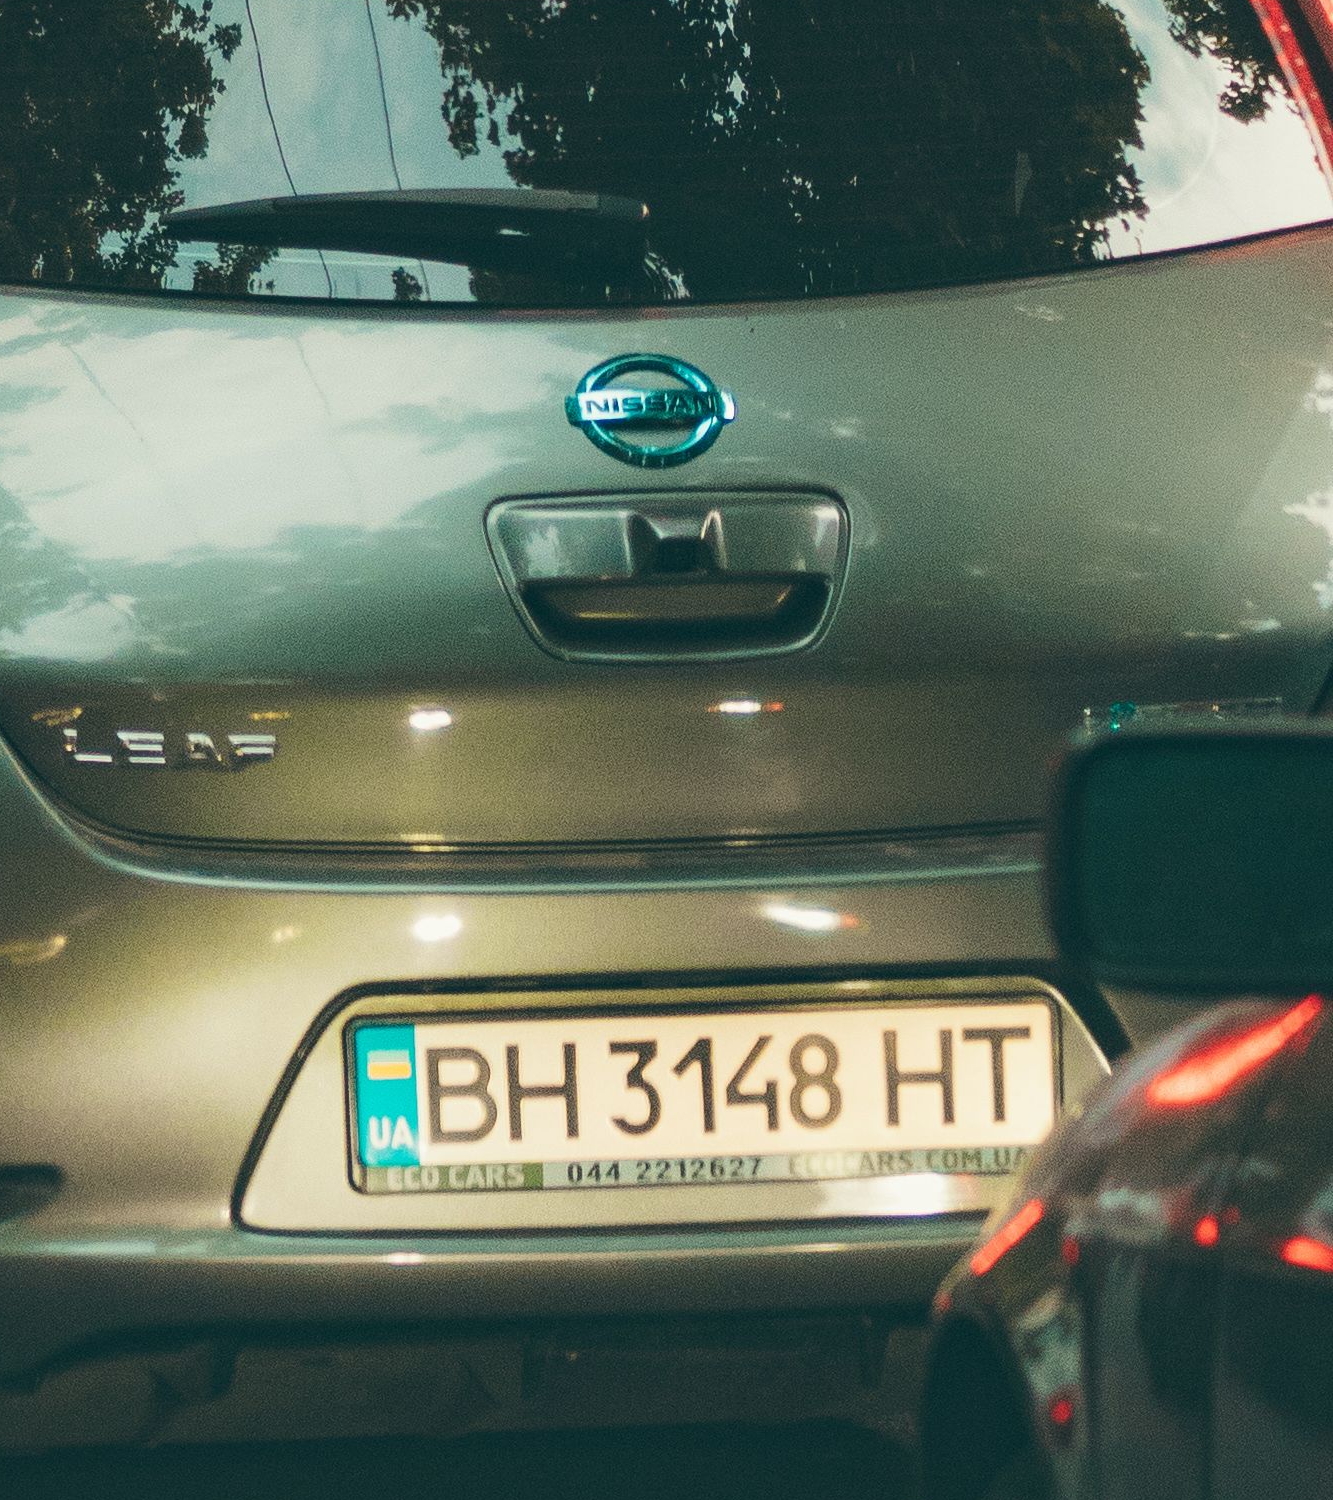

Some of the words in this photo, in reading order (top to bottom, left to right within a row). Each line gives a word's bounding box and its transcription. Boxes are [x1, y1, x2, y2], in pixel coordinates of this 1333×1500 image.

[423, 1043, 580, 1146] BH
[608, 1032, 843, 1137] 3148
[881, 1025, 1032, 1128] HT
[368, 1116, 416, 1150] UA
[387, 1167, 440, 1191] ECO
[448, 1164, 526, 1189] CARS
[566, 1161, 621, 1185] 044
[635, 1156, 762, 1184] 2212627
